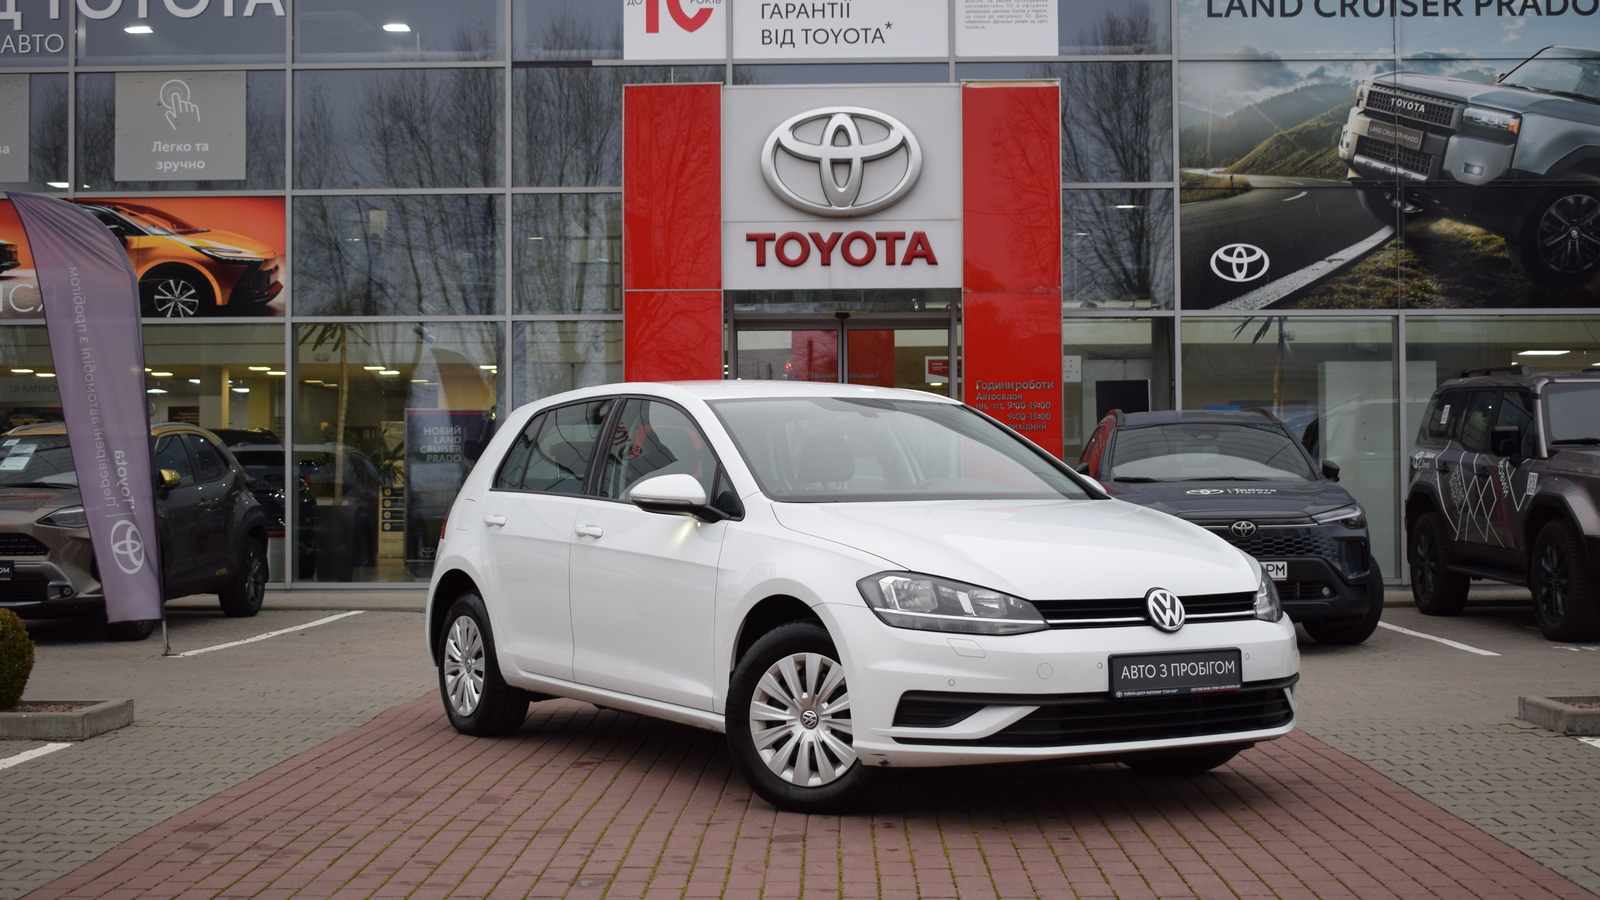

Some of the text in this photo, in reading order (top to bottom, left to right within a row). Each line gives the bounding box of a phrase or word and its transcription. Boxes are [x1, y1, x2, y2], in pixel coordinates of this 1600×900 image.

[761, 0, 852, 19] ГАРАНТІЇ
[1207, 0, 1599, 18] LAND CRUISER PRADO
[761, 29, 795, 48] ВІД
[1391, 98, 1425, 113] TOYOTA
[152, 141, 209, 153] Легко та
[156, 160, 206, 173] зручно
[746, 231, 938, 267] TOYOTA
[976, 380, 1054, 392] Години роботи
[976, 393, 1022, 401] Автосалон
[423, 425, 462, 435] НОВИЙ
[434, 436, 462, 444] LAND
[420, 445, 462, 453] CRUISER
[426, 454, 462, 463] PRADO
[1121, 664, 1156, 680] АВТО
[1171, 660, 1235, 677] ПРОБІГОМ
